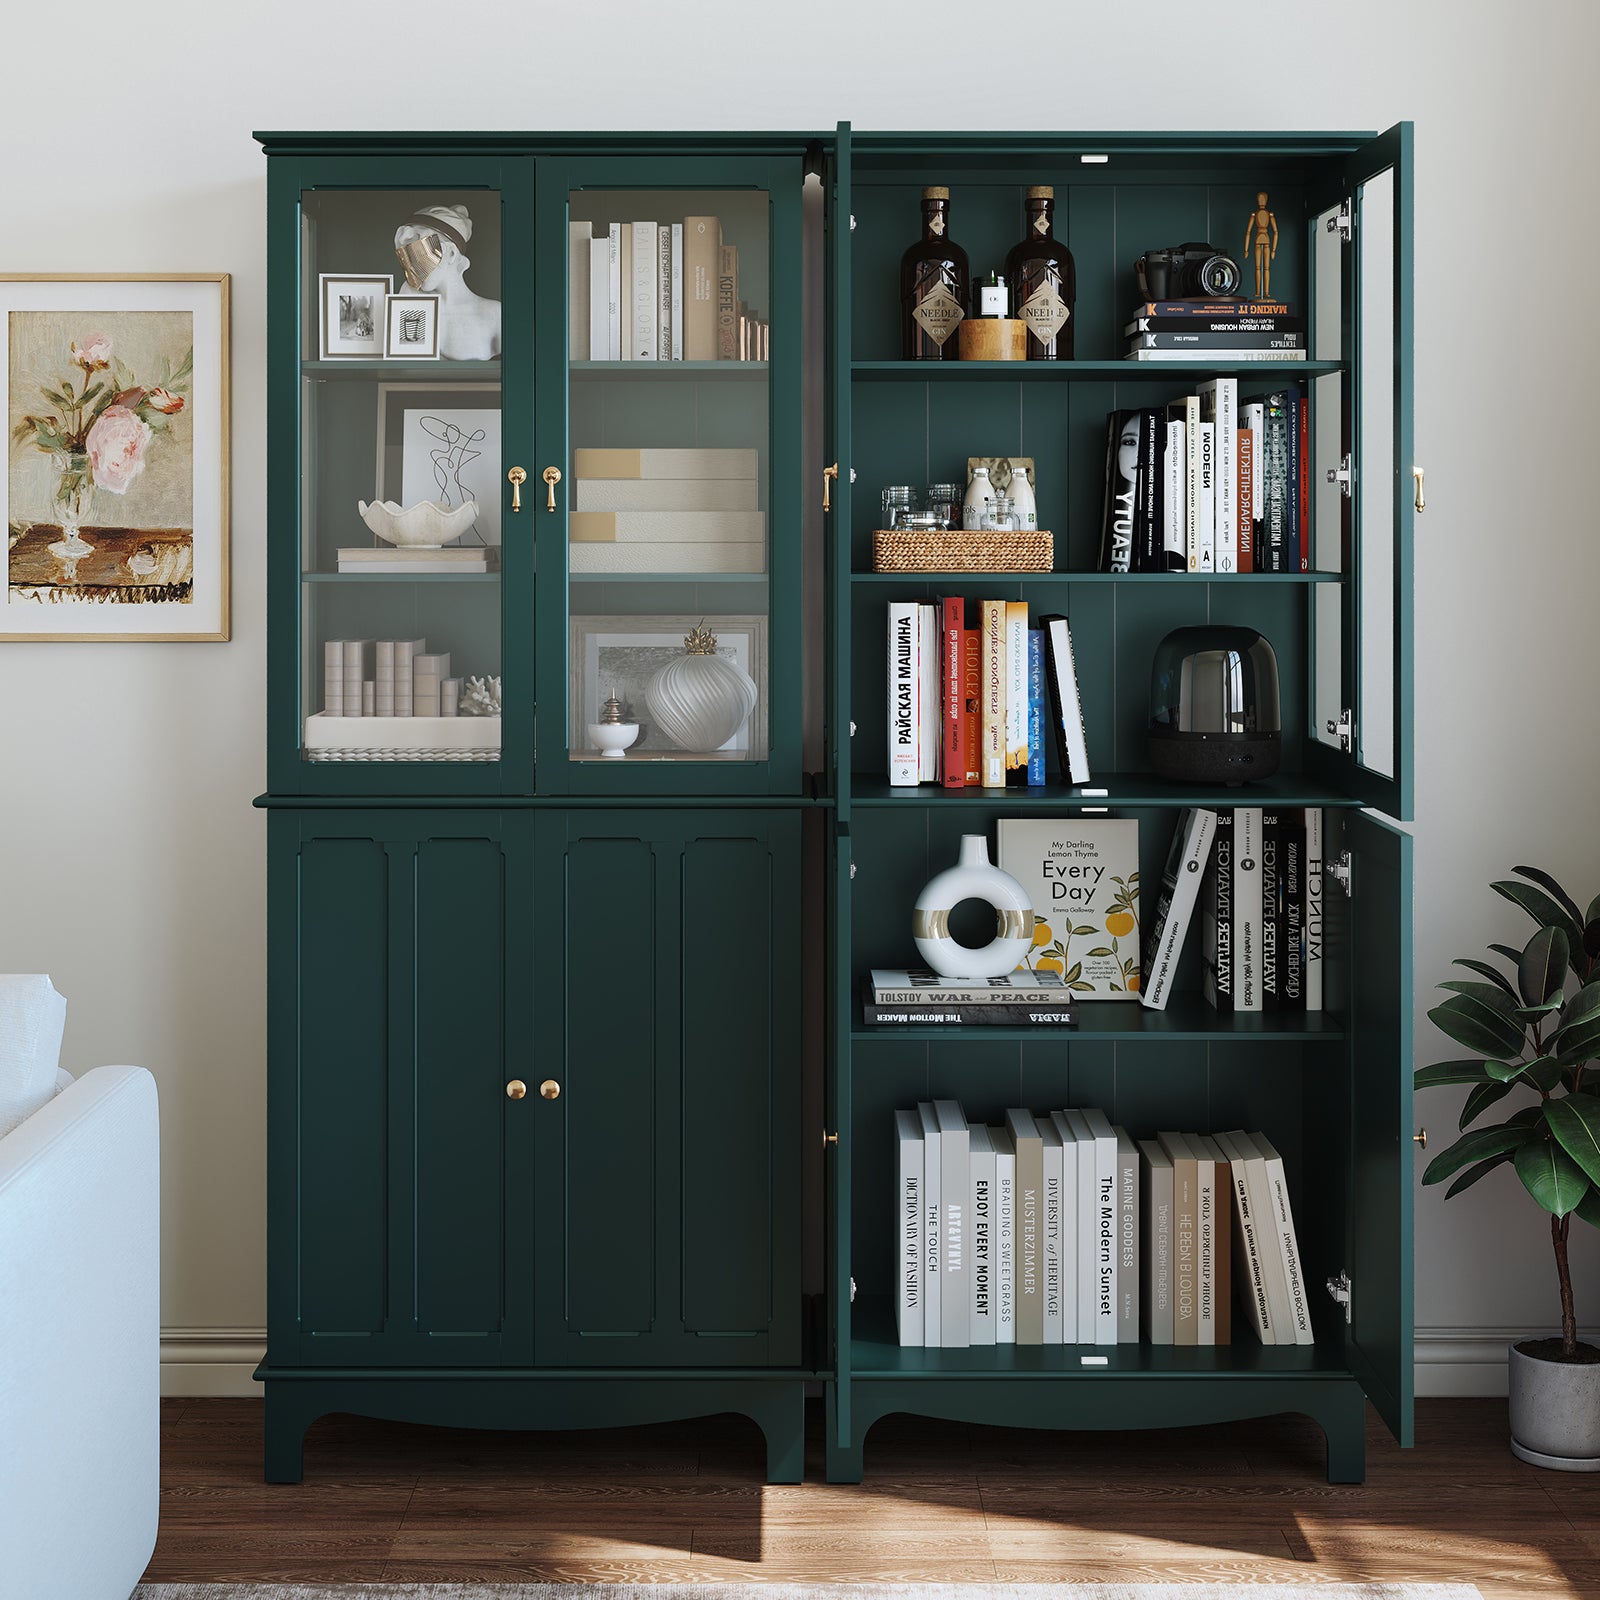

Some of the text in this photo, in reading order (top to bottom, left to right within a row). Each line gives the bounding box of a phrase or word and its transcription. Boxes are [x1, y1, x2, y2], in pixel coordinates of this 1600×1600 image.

[719, 276, 734, 313] KOFFIE
[920, 308, 959, 318] NEEDLE
[1238, 306, 1249, 314] IT
[1249, 305, 1288, 314] MAKING
[638, 293, 651, 346] GLORY
[1037, 327, 1052, 335] GIN
[895, 616, 911, 744] РАЙСКАЯ МАШИНА
[1048, 850, 1098, 859] Lemon Thyme
[1052, 841, 1095, 850] My Darling
[1043, 861, 1105, 883] Every
[1052, 882, 1096, 905] Day
[879, 993, 921, 1002] TOLSTOY
[928, 993, 973, 1001] WAR
[990, 993, 1050, 1001] PEACE
[928, 1205, 937, 1272] THE TOUCH
[1123, 1168, 1133, 1267] MARINE GODDESS
[906, 1177, 917, 1308] DICTIONARY OF FASHION
[977, 1180, 988, 1316] ENJOY EVERY MOMENT
[1001, 1179, 1011, 1322] BRAIDING SWEETGRASS
[1024, 1189, 1035, 1294] MUSTERZIMMER
[1046, 1178, 1058, 1316] DIVERSITY of HERITAGE
[1101, 1176, 1113, 1316] The Modern Sunset
